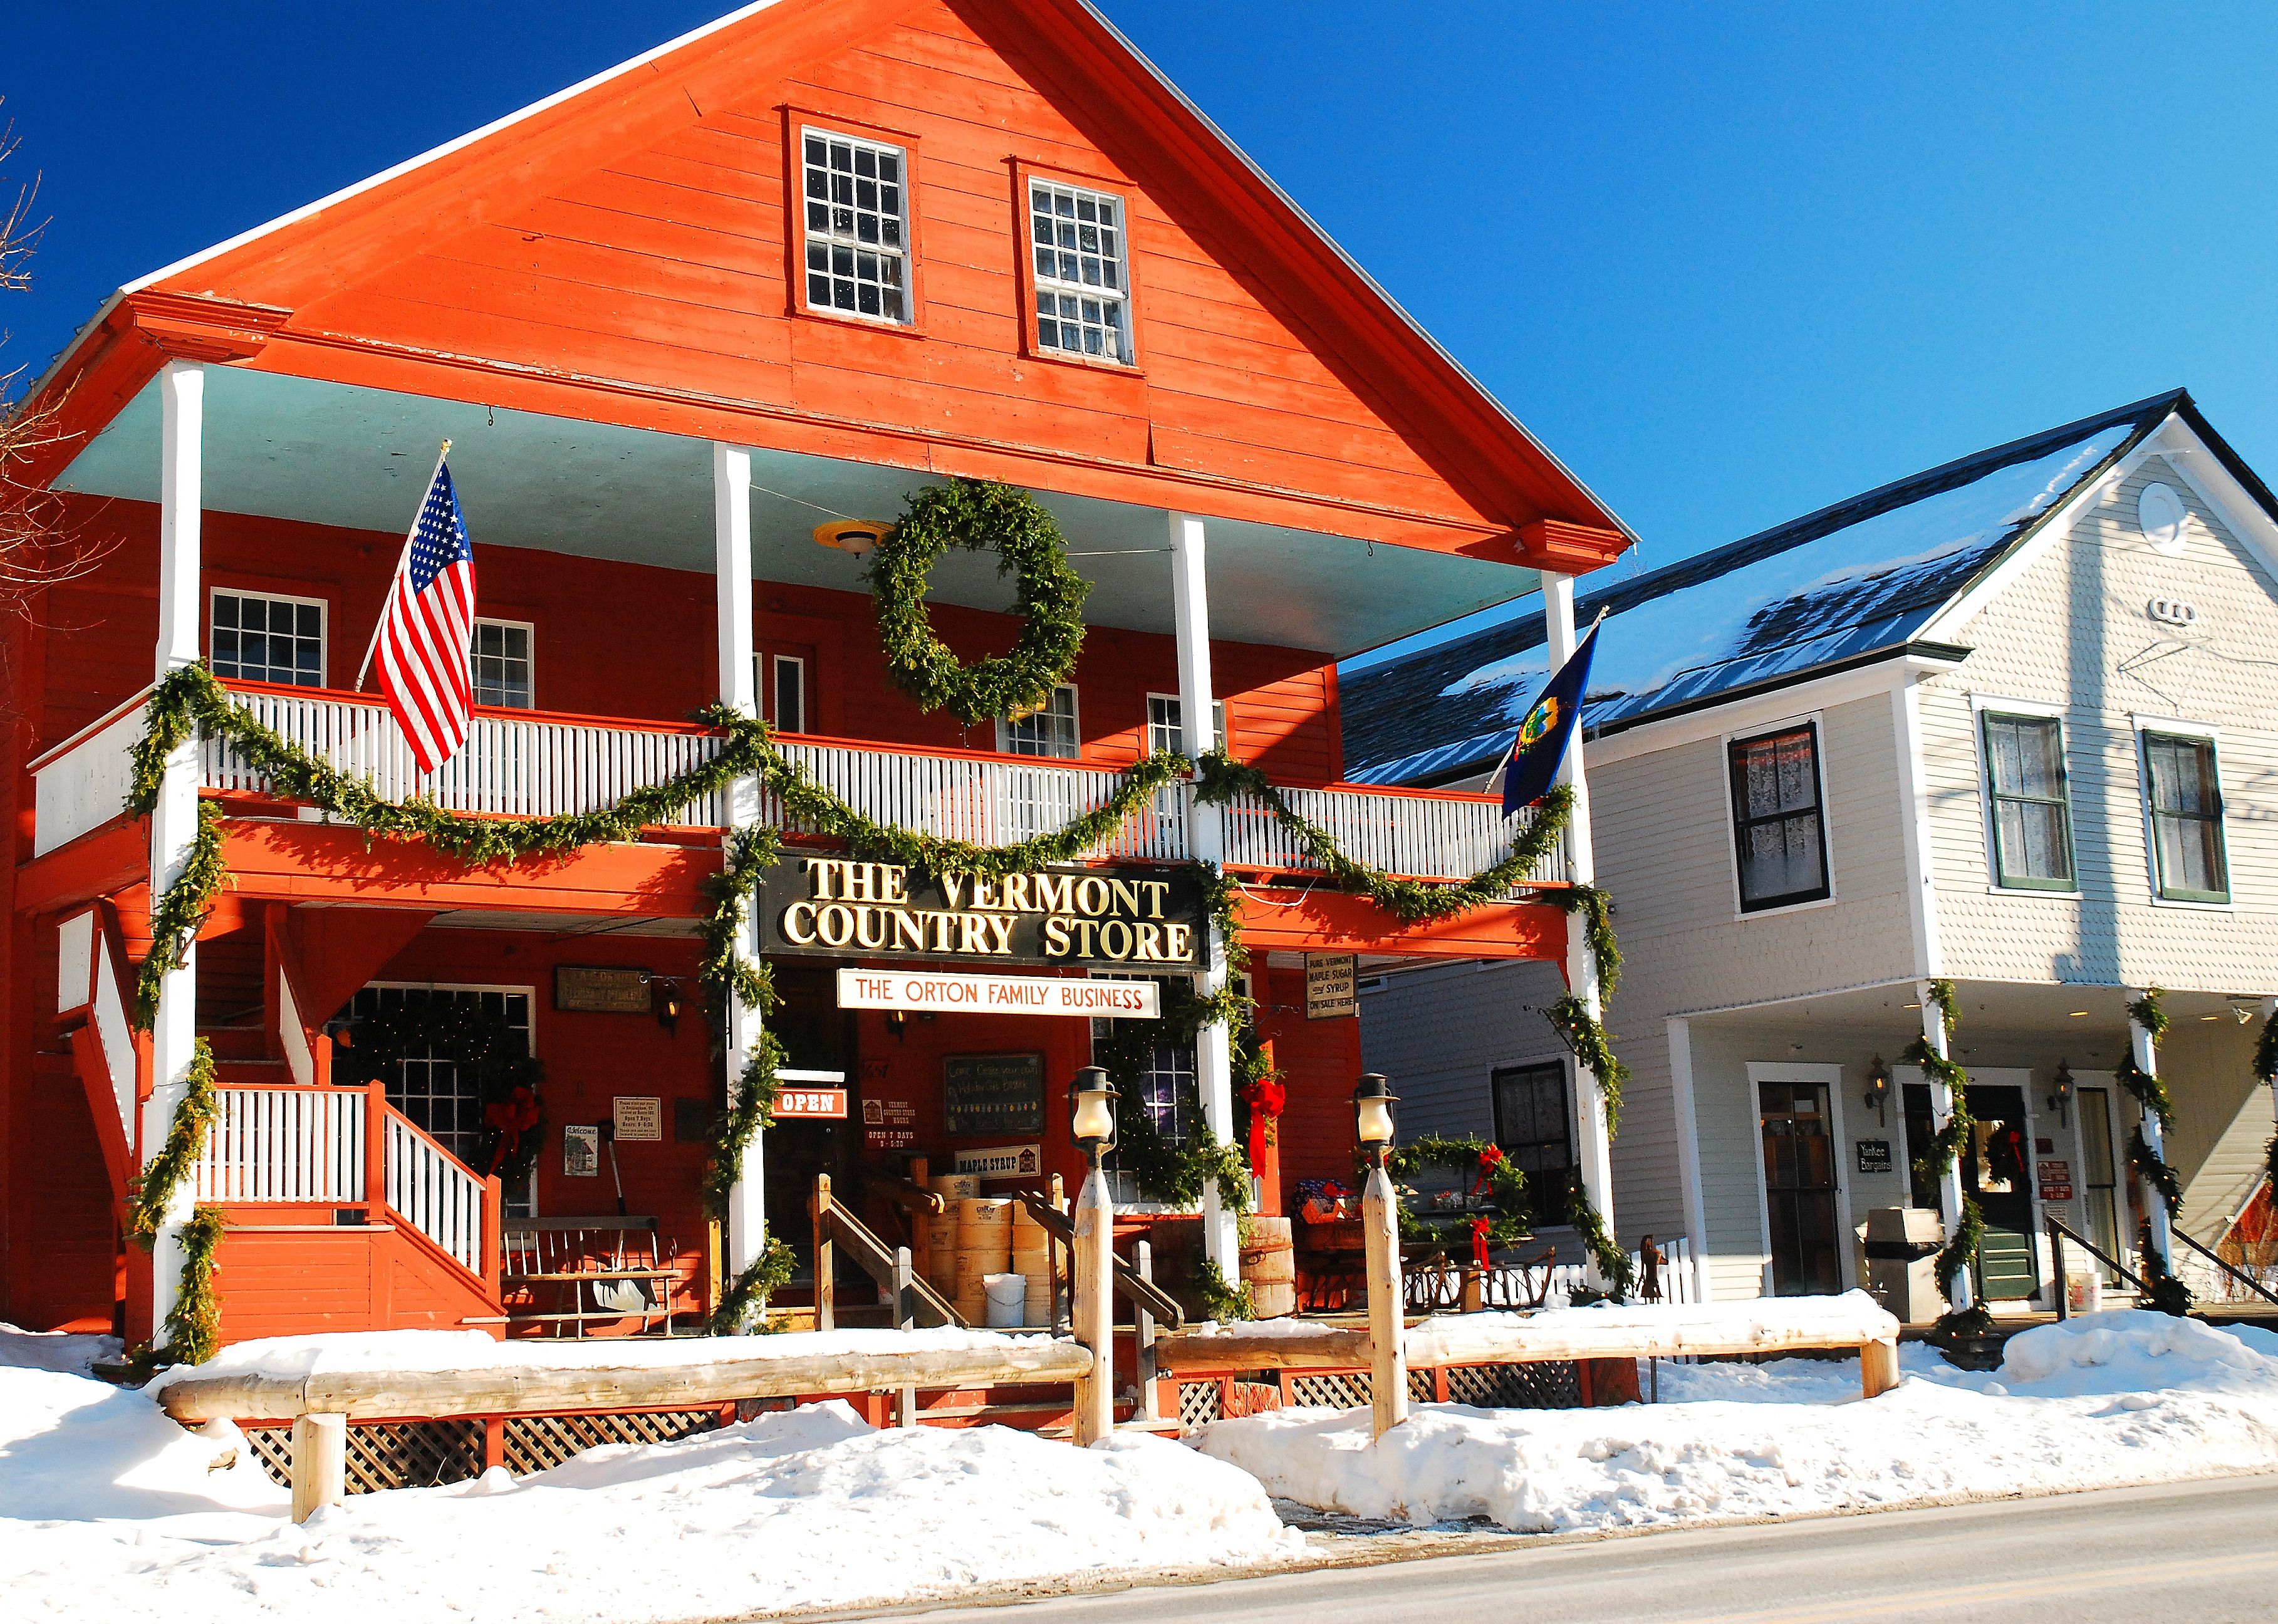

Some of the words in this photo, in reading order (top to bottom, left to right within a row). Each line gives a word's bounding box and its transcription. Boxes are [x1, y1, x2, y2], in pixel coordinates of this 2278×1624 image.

[807, 858, 908, 905] THE
[941, 870, 1170, 919] VERMONT
[783, 902, 1019, 954] COUNTRY
[1045, 916, 1194, 962] STORE
[1309, 959, 1323, 968] PURE
[1326, 955, 1352, 966] VERMONT
[1309, 971, 1329, 982] MAPLE
[1332, 967, 1353, 979] SUGAR
[855, 979, 893, 1000] THE
[905, 981, 978, 1003] ORTON
[988, 984, 1049, 1005] FAMILY
[1061, 987, 1143, 1010] BUSINESS
[1326, 982, 1350, 994] SYRUP
[1310, 1001, 1318, 1010] ON
[1321, 999, 1334, 1009] SALE
[1338, 998, 1353, 1007] HERE
[782, 1093, 835, 1111] OPEN
[567, 1127, 597, 1135] Welcome
[959, 1158, 988, 1173] MAPLE
[990, 1156, 1016, 1170] SYRUP
[1861, 1158, 1893, 1172] Bargains
